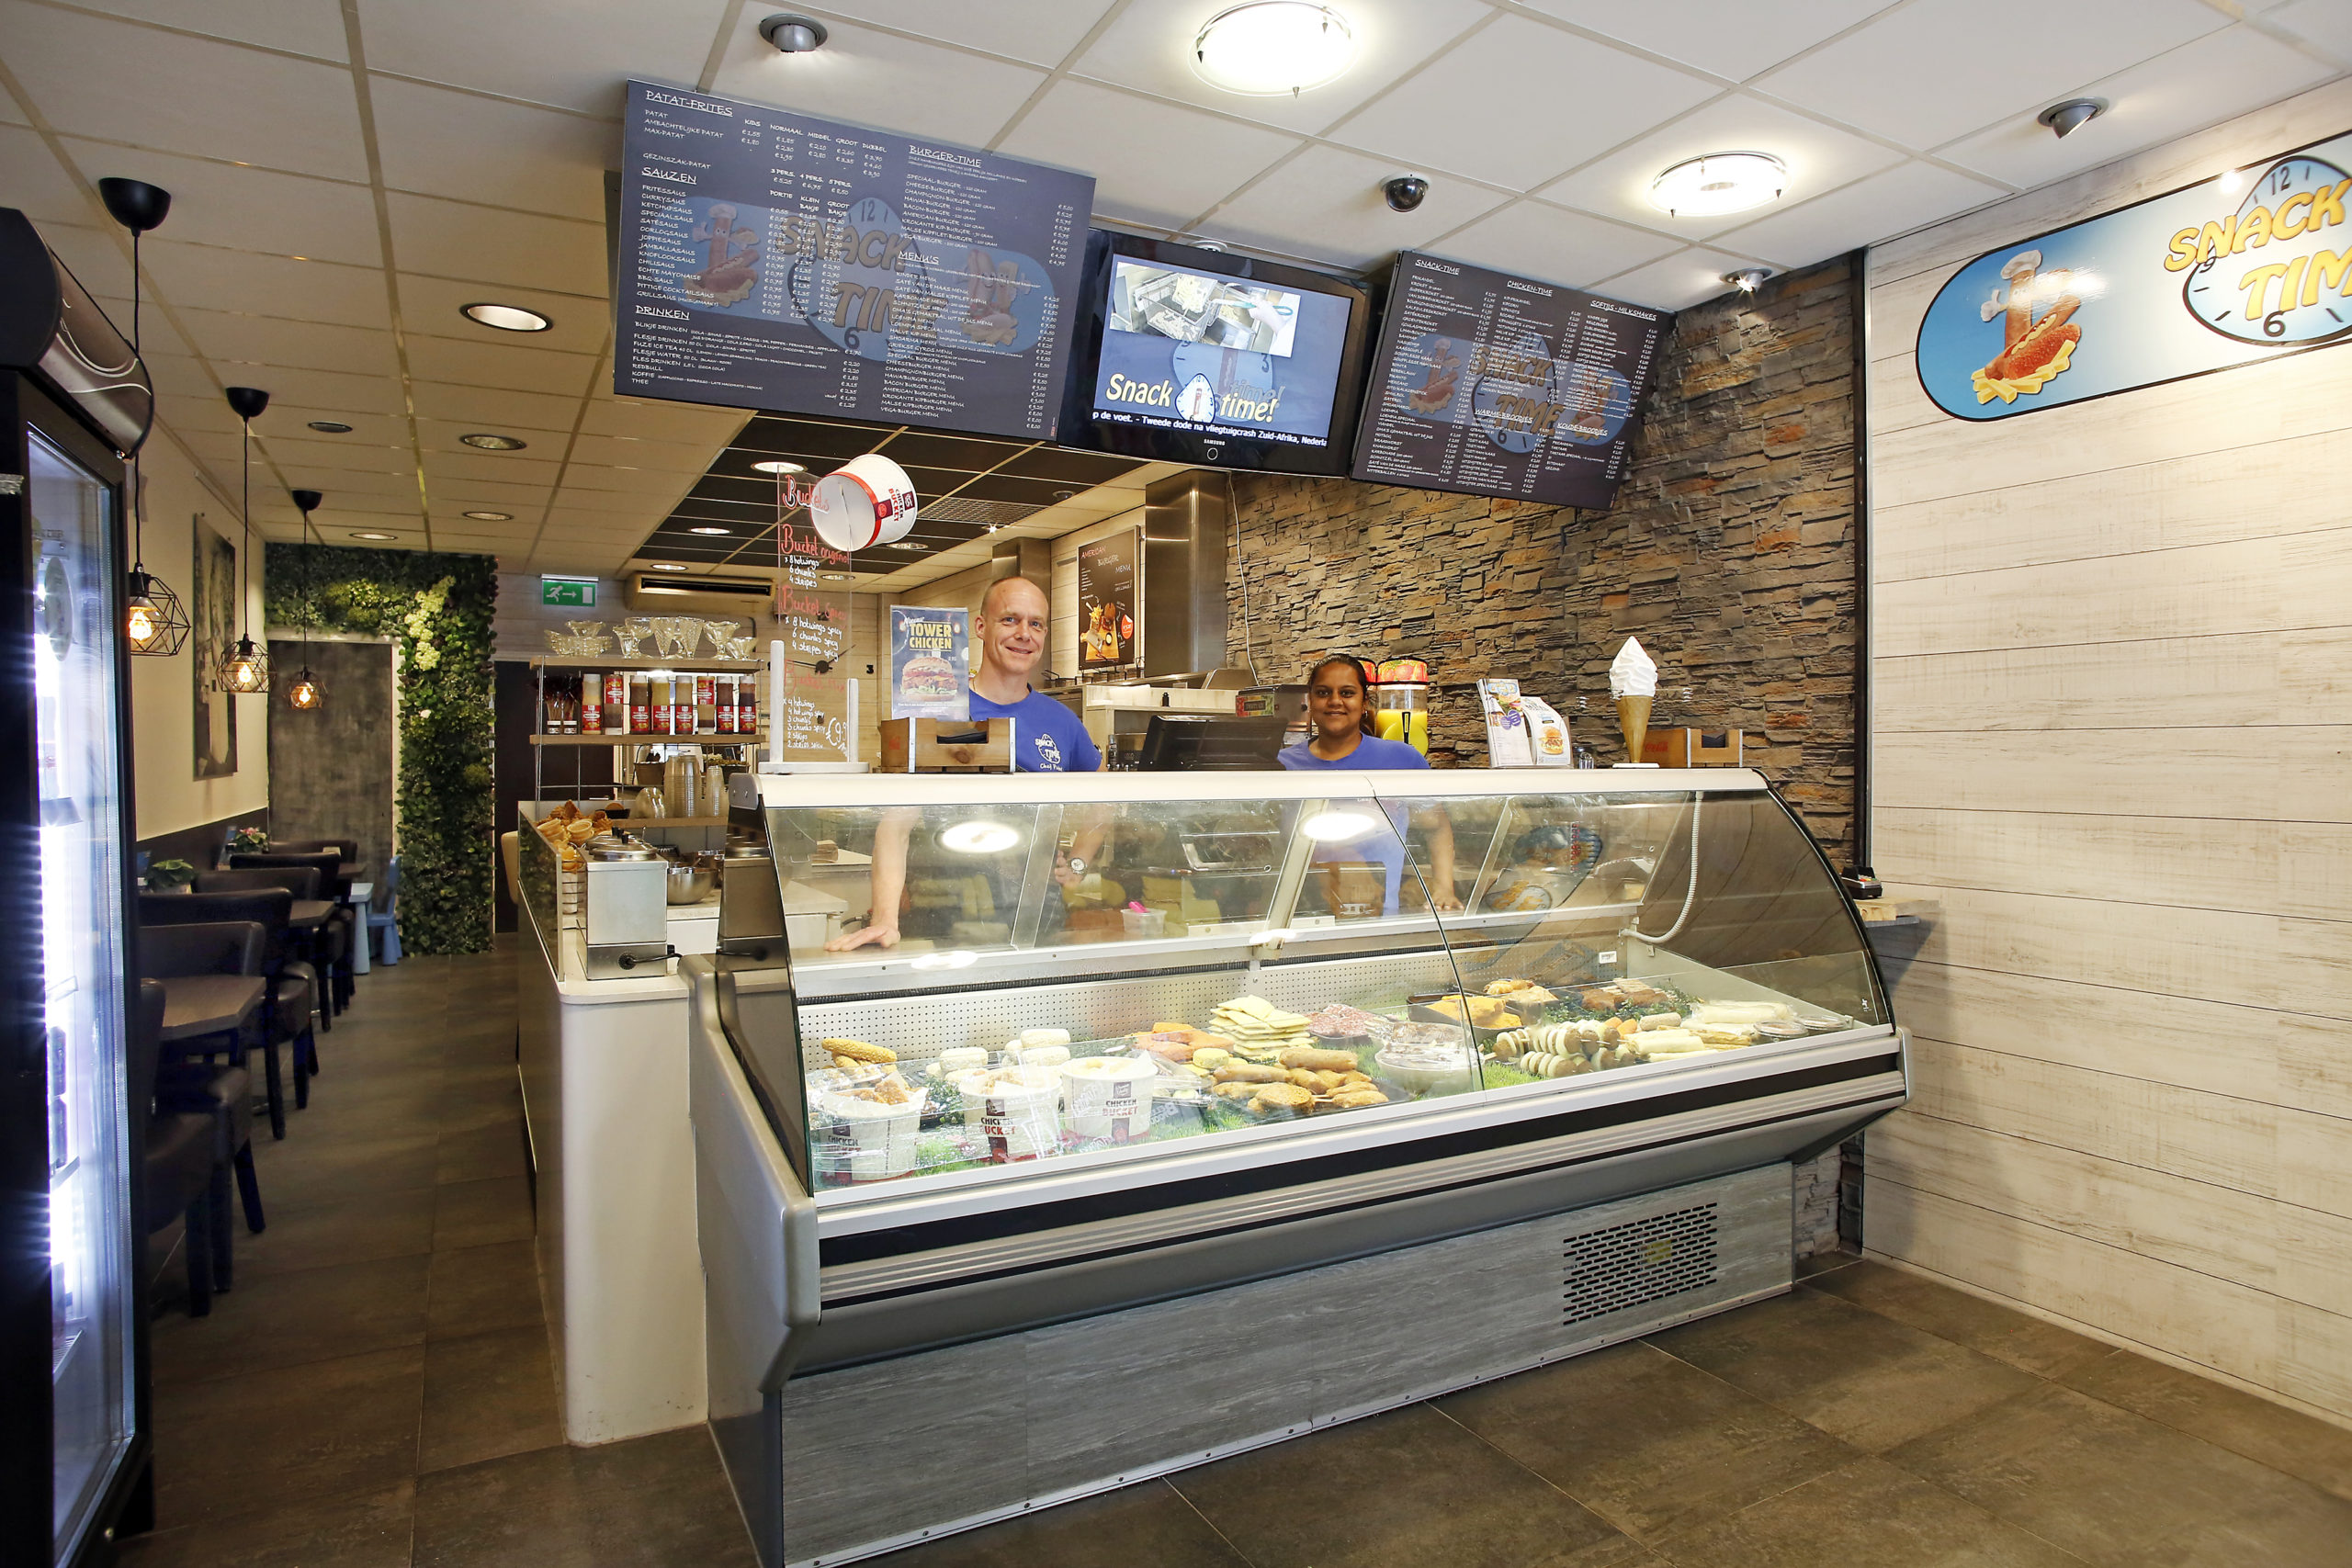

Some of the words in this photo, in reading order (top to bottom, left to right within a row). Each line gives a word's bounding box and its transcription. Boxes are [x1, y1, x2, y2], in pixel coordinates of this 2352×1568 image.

[646, 90, 733, 117] PATAT-FRITES
[645, 109, 668, 118] PATAT
[701, 130, 723, 138] PATAT
[770, 124, 803, 135] NORMAAL
[808, 131, 831, 141] MIDDEL
[835, 138, 858, 146] GROOT
[909, 145, 981, 168] BURGER-TIME
[641, 166, 697, 185] SAUZEN
[2271, 167, 2291, 195] 12
[641, 193, 685, 206] CURRYSAUS
[642, 185, 686, 197] FRITESSAUS
[770, 190, 792, 198] PORTIE
[800, 196, 820, 204] KLEIN
[827, 200, 849, 209] GROOT
[640, 209, 693, 222] SPECIAALSAUS
[640, 226, 688, 238] OORLOGSAUS
[2164, 178, 2352, 273] SNACK
[776, 216, 910, 272] SNACK
[639, 251, 695, 264] KNOFLOOKSAUS
[898, 251, 939, 265] MENU'S
[1415, 258, 1460, 276] SNACK-TIME
[1507, 279, 1553, 297] CHICKEN-TIME
[636, 305, 690, 320] DRINKEN
[831, 282, 948, 340] TIME
[1617, 306, 1657, 321] MILKSHAKES
[658, 324, 687, 333] DRINKEN
[2263, 310, 2287, 337] 6
[658, 336, 687, 344] DRINKEN
[1105, 373, 1173, 407] Snack
[1220, 391, 1280, 423] time!
[1101, 412, 1111, 420] de
[1114, 413, 1133, 423] voet.
[1142, 416, 1171, 428] Tweede
[1173, 421, 1192, 430] dode
[1205, 424, 1256, 438] vliegtuigcrash
[1259, 431, 1299, 445] Zuid-Afrika,
[888, 488, 899, 522] BUCKET
[895, 489, 904, 519] CHICKEN
[781, 524, 819, 556] Bucket
[1080, 546, 1106, 558] AMERICAN
[1097, 554, 1119, 567] BURGER
[1115, 563, 1131, 573] MENU
[781, 585, 820, 615] Bucket
[793, 616, 798, 626] 8
[798, 616, 826, 636] hotwings
[828, 626, 842, 640] spicy
[909, 623, 952, 637] TOWER
[792, 627, 797, 638] 6
[799, 631, 822, 643] chunks
[824, 637, 839, 651] spicy
[909, 637, 952, 649] CHICKEN
[792, 640, 797, 650] 4
[824, 649, 839, 662] spicy
[866, 664, 875, 674] 3
[1102, 1106, 1138, 1117] BUCKET
[1106, 1099, 1137, 1108] CHICKEN
